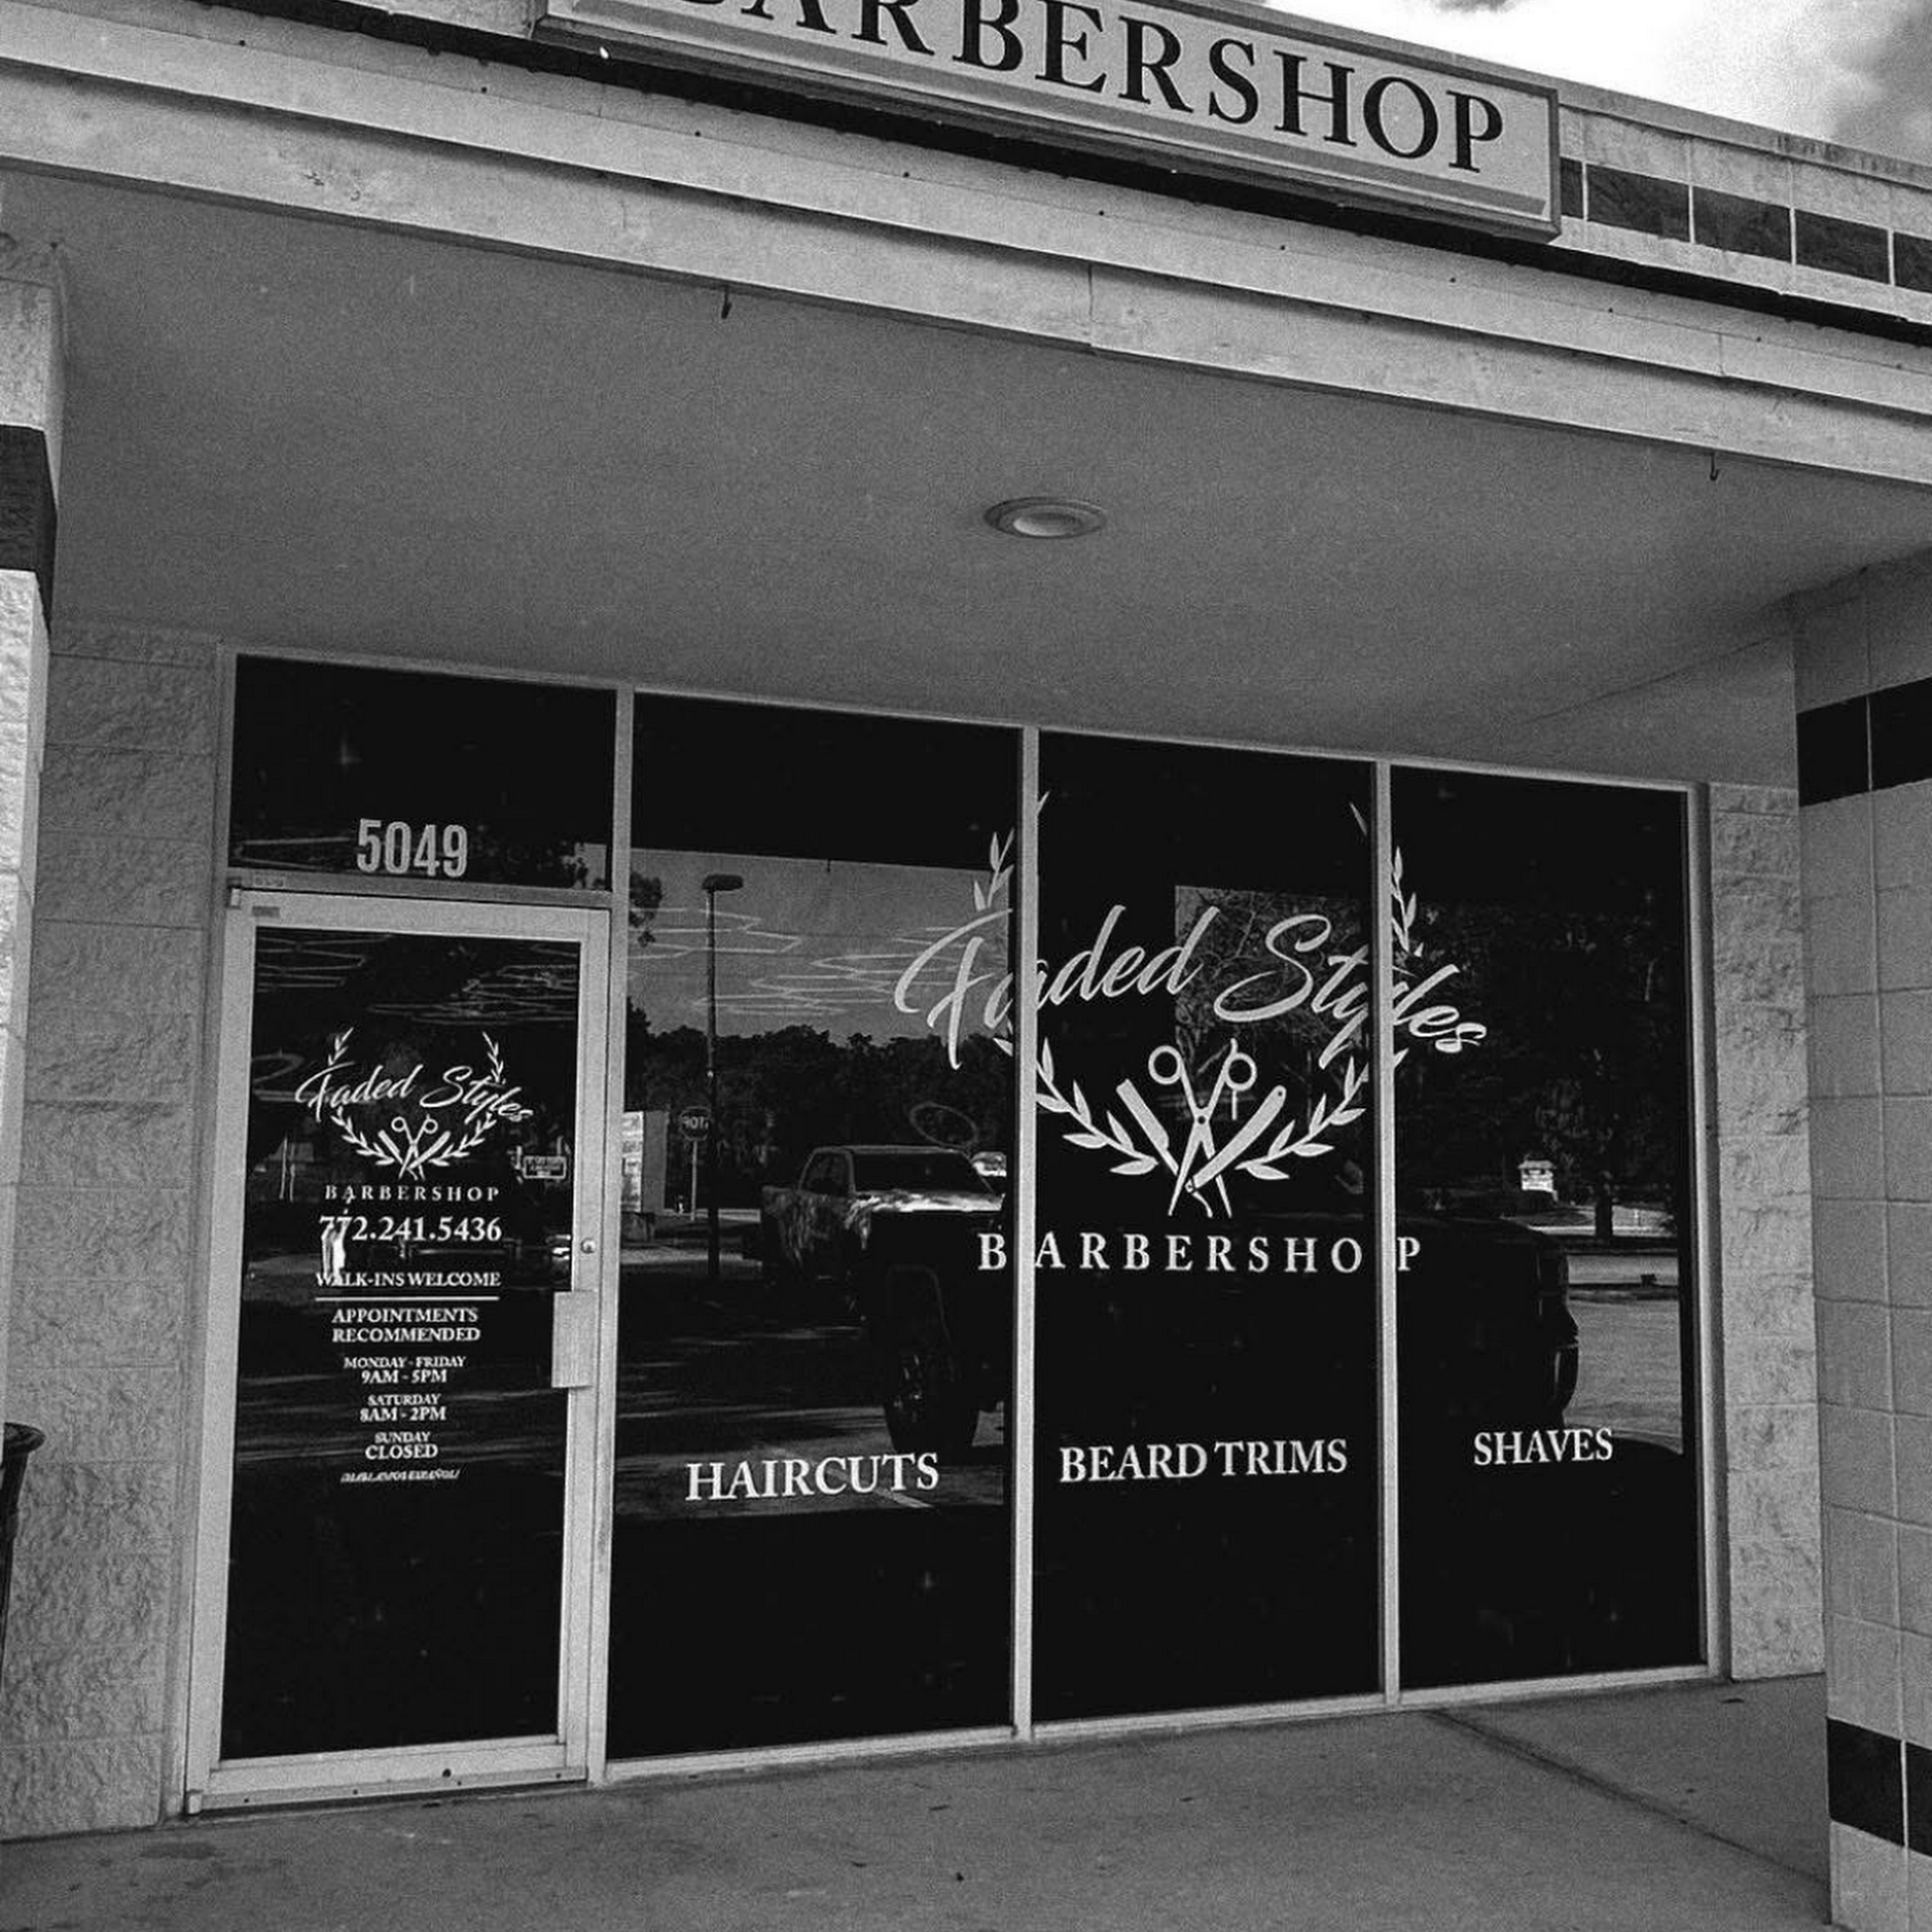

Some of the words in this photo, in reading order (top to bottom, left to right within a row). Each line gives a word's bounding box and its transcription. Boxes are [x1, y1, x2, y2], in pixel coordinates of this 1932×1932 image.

[678, 0, 1503, 173] RBERSHOP
[357, 818, 468, 877] 5049
[895, 905, 1219, 1069] Faded
[1213, 914, 1487, 1069] Styles
[296, 1063, 424, 1122] Faded
[419, 1065, 533, 1124] Styles
[325, 1184, 498, 1202] BARBERSHOP
[319, 1215, 502, 1241] 772.241.5436
[978, 1232, 1420, 1273] BARBERSHOP
[316, 1271, 405, 1287] WALK-INS
[407, 1271, 501, 1287] WELCOME
[331, 1307, 479, 1323] APPOINTMENTS
[331, 1327, 482, 1343] RECOMMENDED
[343, 1356, 408, 1369] MONDAY
[415, 1355, 467, 1367] FRIDAY
[361, 1369, 399, 1384] 9AM
[412, 1369, 448, 1383] 5PM
[367, 1393, 441, 1406] SATURDAY
[359, 1407, 397, 1423] 8AM
[410, 1406, 446, 1421] 2PM
[374, 1432, 431, 1444] SUNDAY
[1473, 1426, 1613, 1466] SHAVES
[365, 1443, 439, 1460] CLOSED
[1059, 1443, 1208, 1484] BEARD
[1213, 1438, 1349, 1476] TRIMS
[685, 1453, 939, 1502] HAIRCUTS
